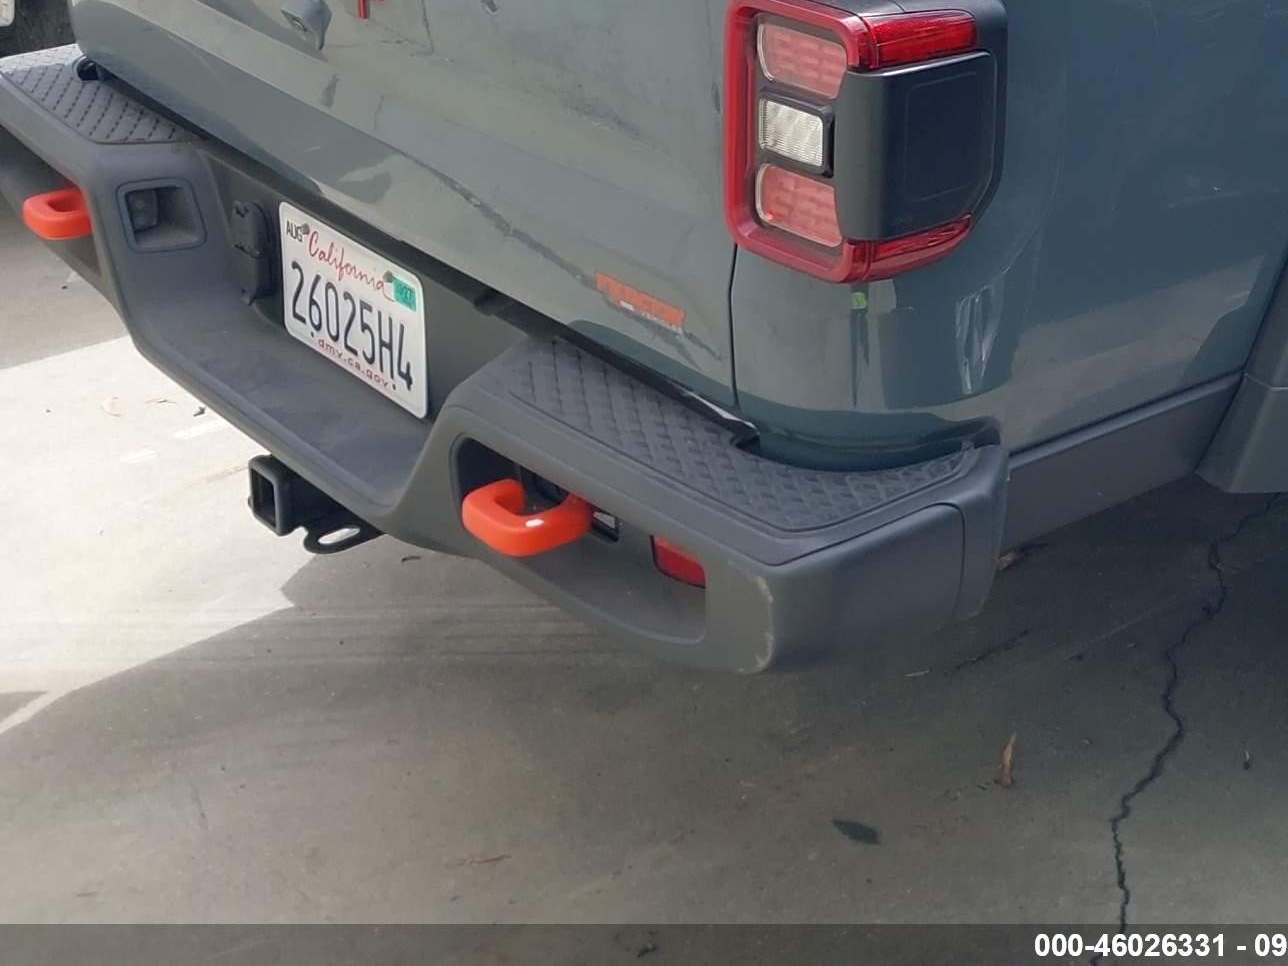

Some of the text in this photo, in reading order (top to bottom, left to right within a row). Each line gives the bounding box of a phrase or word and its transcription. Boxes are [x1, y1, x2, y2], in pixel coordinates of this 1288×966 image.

[309, 230, 395, 302] California
[291, 260, 413, 391] 26025H4
[317, 336, 389, 387] dmv.ca.gov
